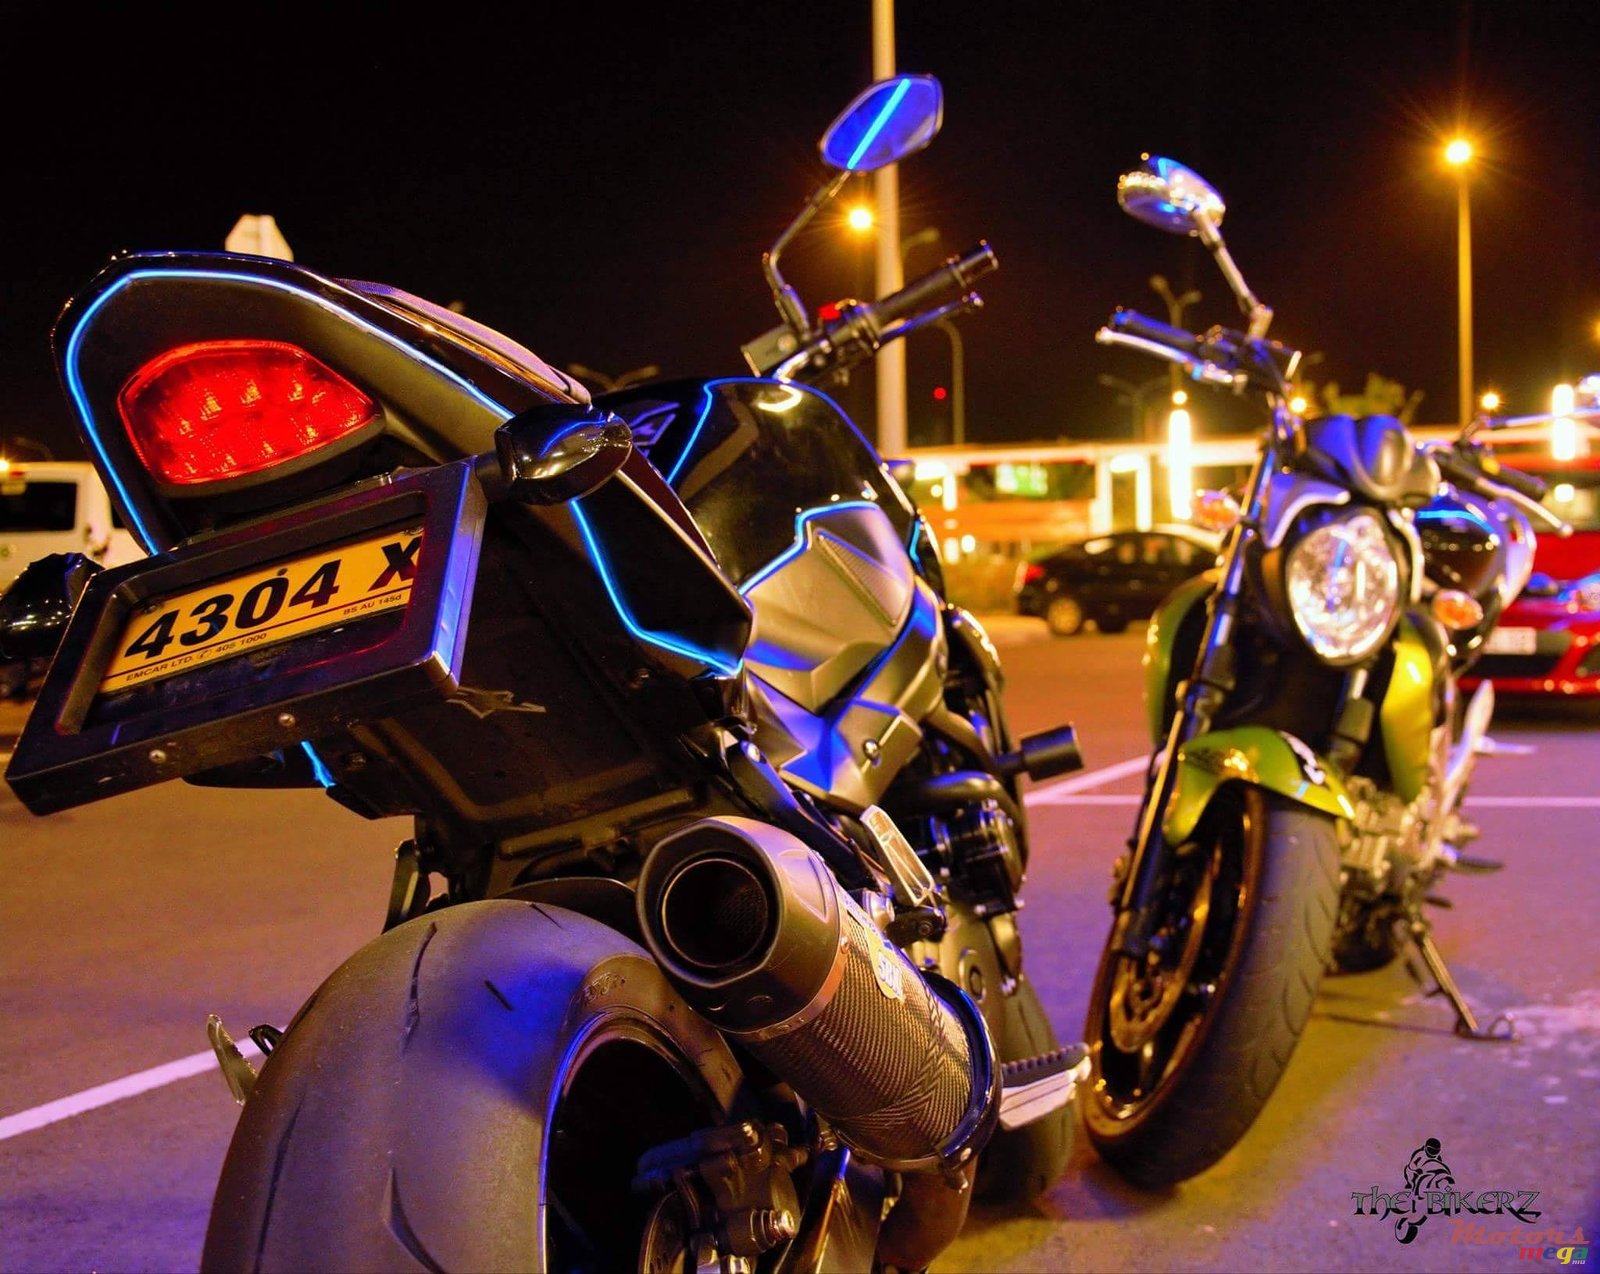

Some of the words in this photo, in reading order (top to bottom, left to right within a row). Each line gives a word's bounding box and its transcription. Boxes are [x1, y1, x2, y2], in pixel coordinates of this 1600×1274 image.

[124, 558, 341, 660] 4304
[367, 535, 423, 593] X
[360, 601, 375, 611] AU
[126, 663, 169, 682] EMCAR
[240, 632, 268, 646] 1000
